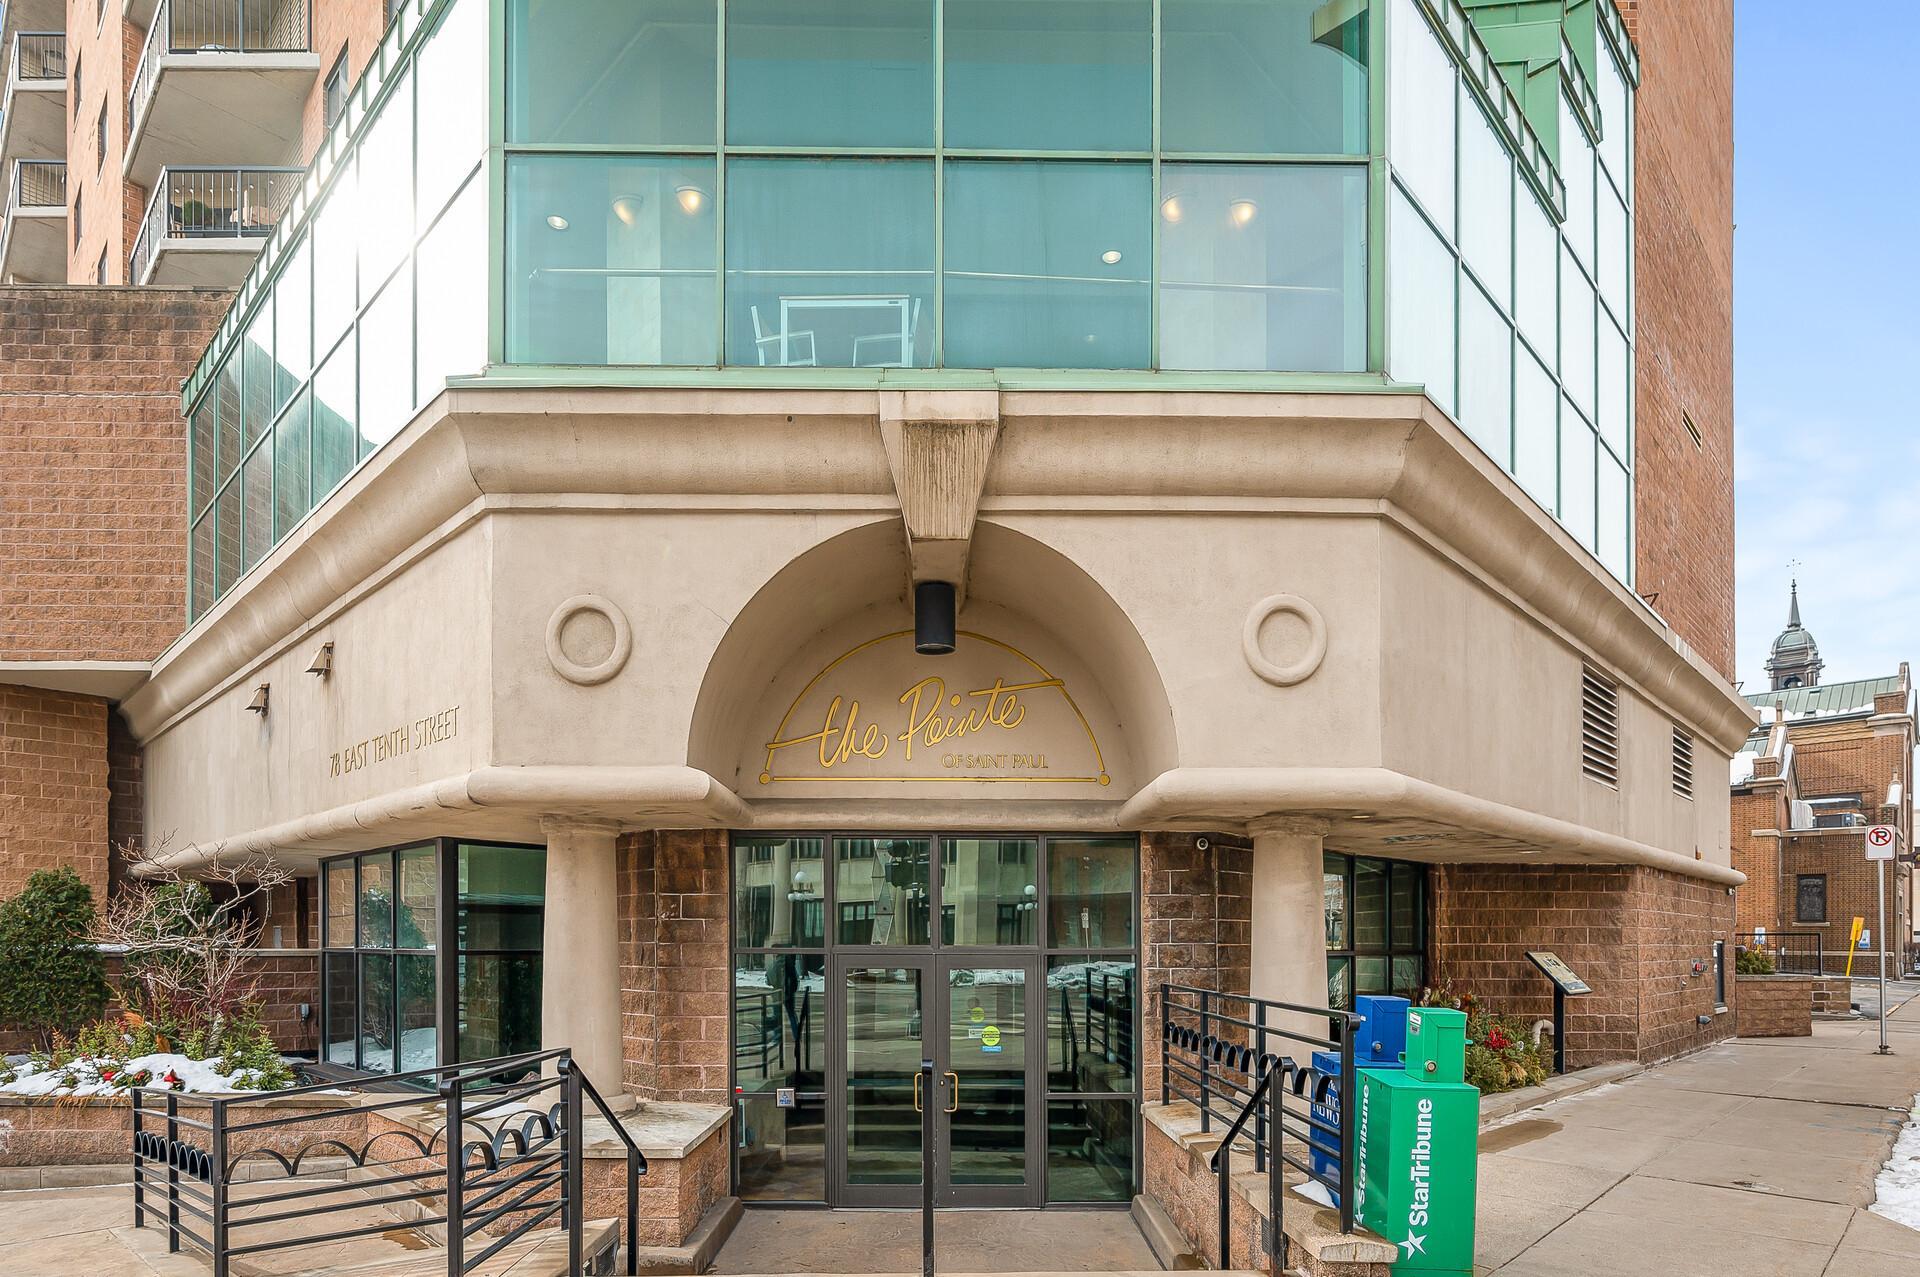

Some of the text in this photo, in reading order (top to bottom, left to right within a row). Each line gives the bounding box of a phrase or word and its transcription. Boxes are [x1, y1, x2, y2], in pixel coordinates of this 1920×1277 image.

[329, 705, 460, 778] 78 EAST TENTH STREET
[766, 676, 1064, 767] the Pointe
[942, 753, 1049, 769] OF SAINT PAUL
[1357, 1084, 1370, 1205] StarTribune
[1408, 1098, 1433, 1227] StarTribune
